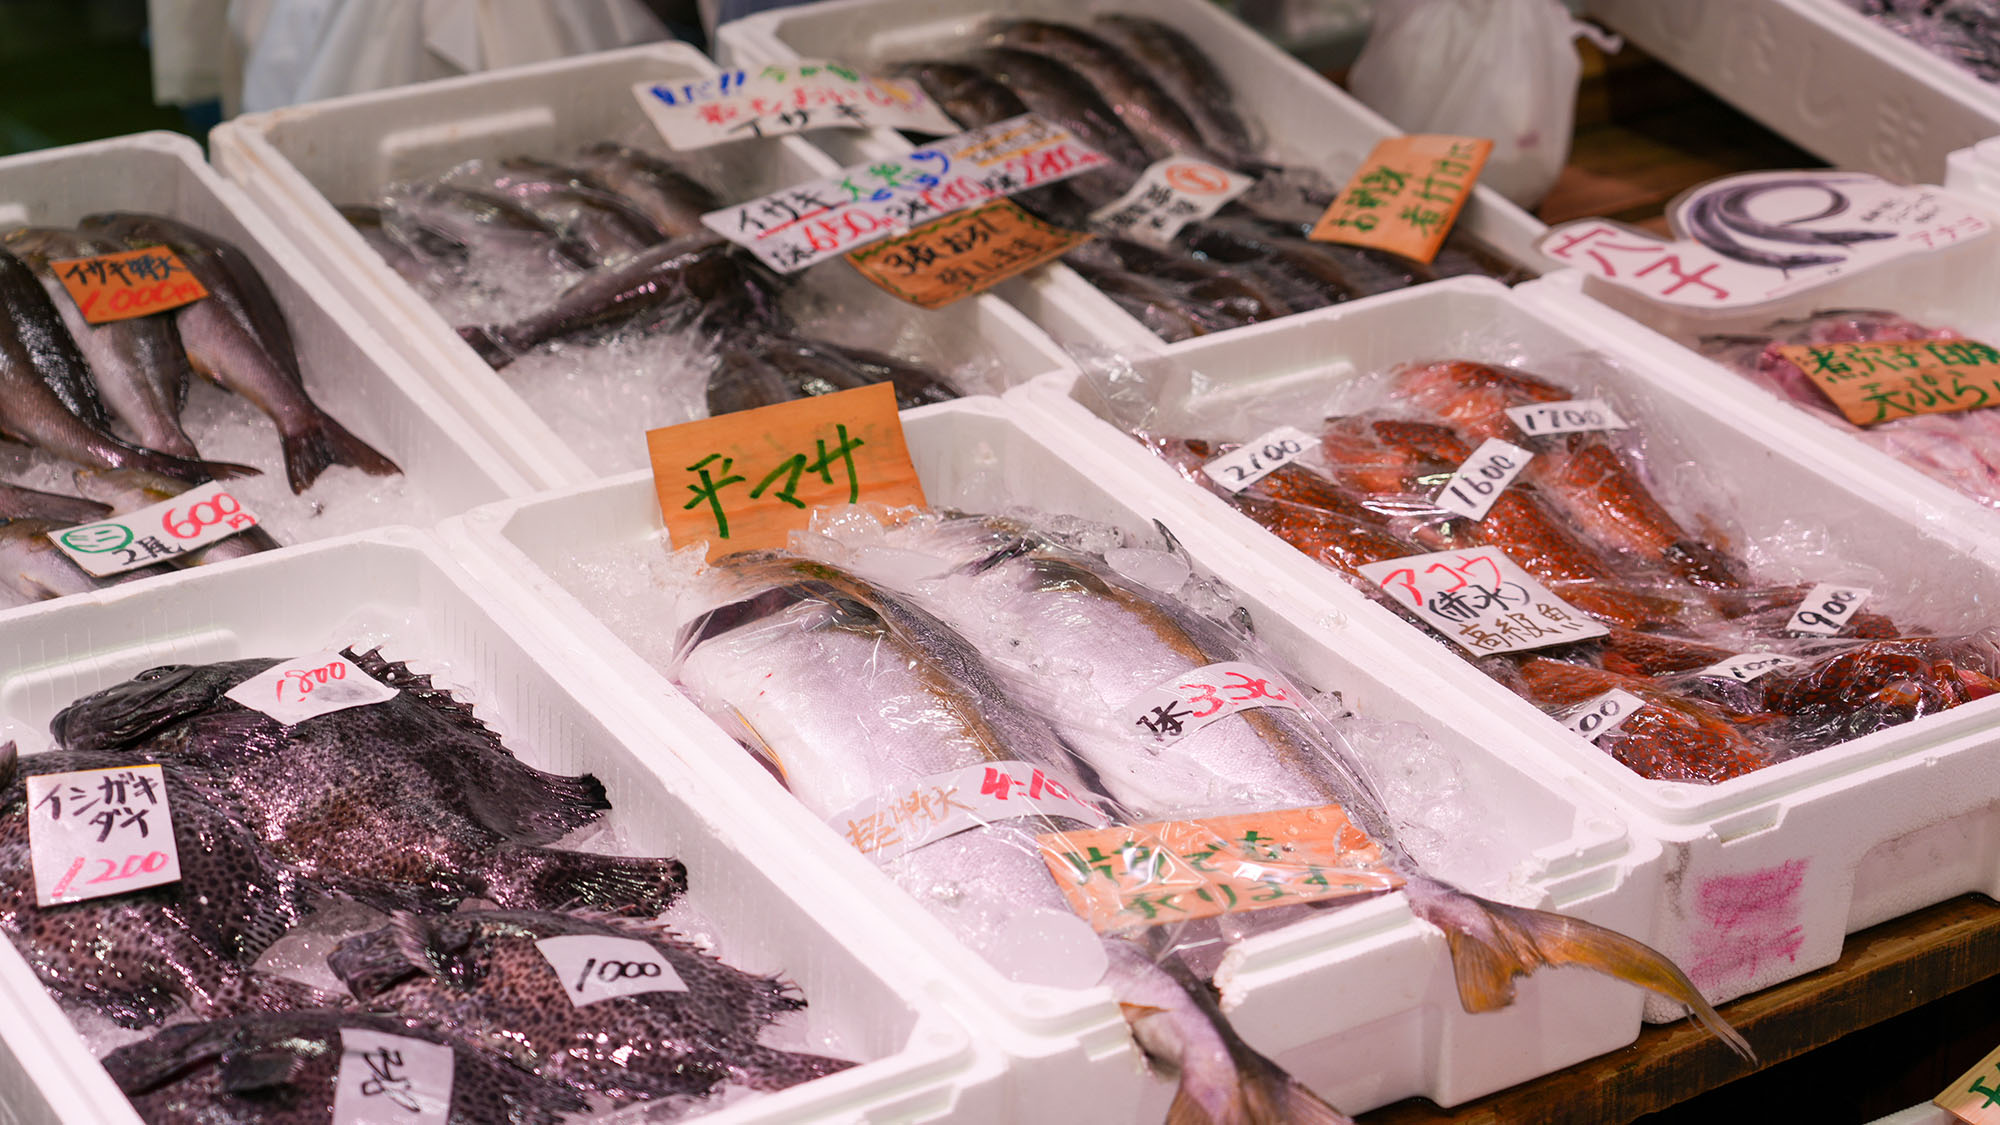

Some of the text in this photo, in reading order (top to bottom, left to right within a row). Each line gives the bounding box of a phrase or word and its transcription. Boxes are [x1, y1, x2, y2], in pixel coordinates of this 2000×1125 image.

[740, 188, 836, 232] イサキ
[1552, 227, 1730, 300] 穴子
[1524, 408, 1603, 432] 1700
[1859, 370, 2000, 421] 天ぷら
[682, 423, 865, 540] 平マサ
[1223, 438, 1301, 483] 2100
[1450, 452, 1516, 509] 1600
[162, 491, 257, 540] 600円
[1380, 554, 1502, 607] アコウ
[1458, 602, 1585, 651] 高級魚
[1797, 590, 1858, 630] 900
[1568, 699, 1621, 735] 00
[34, 770, 161, 822] イシガキ
[88, 806, 151, 843] ダイ
[575, 957, 663, 993] 1000
